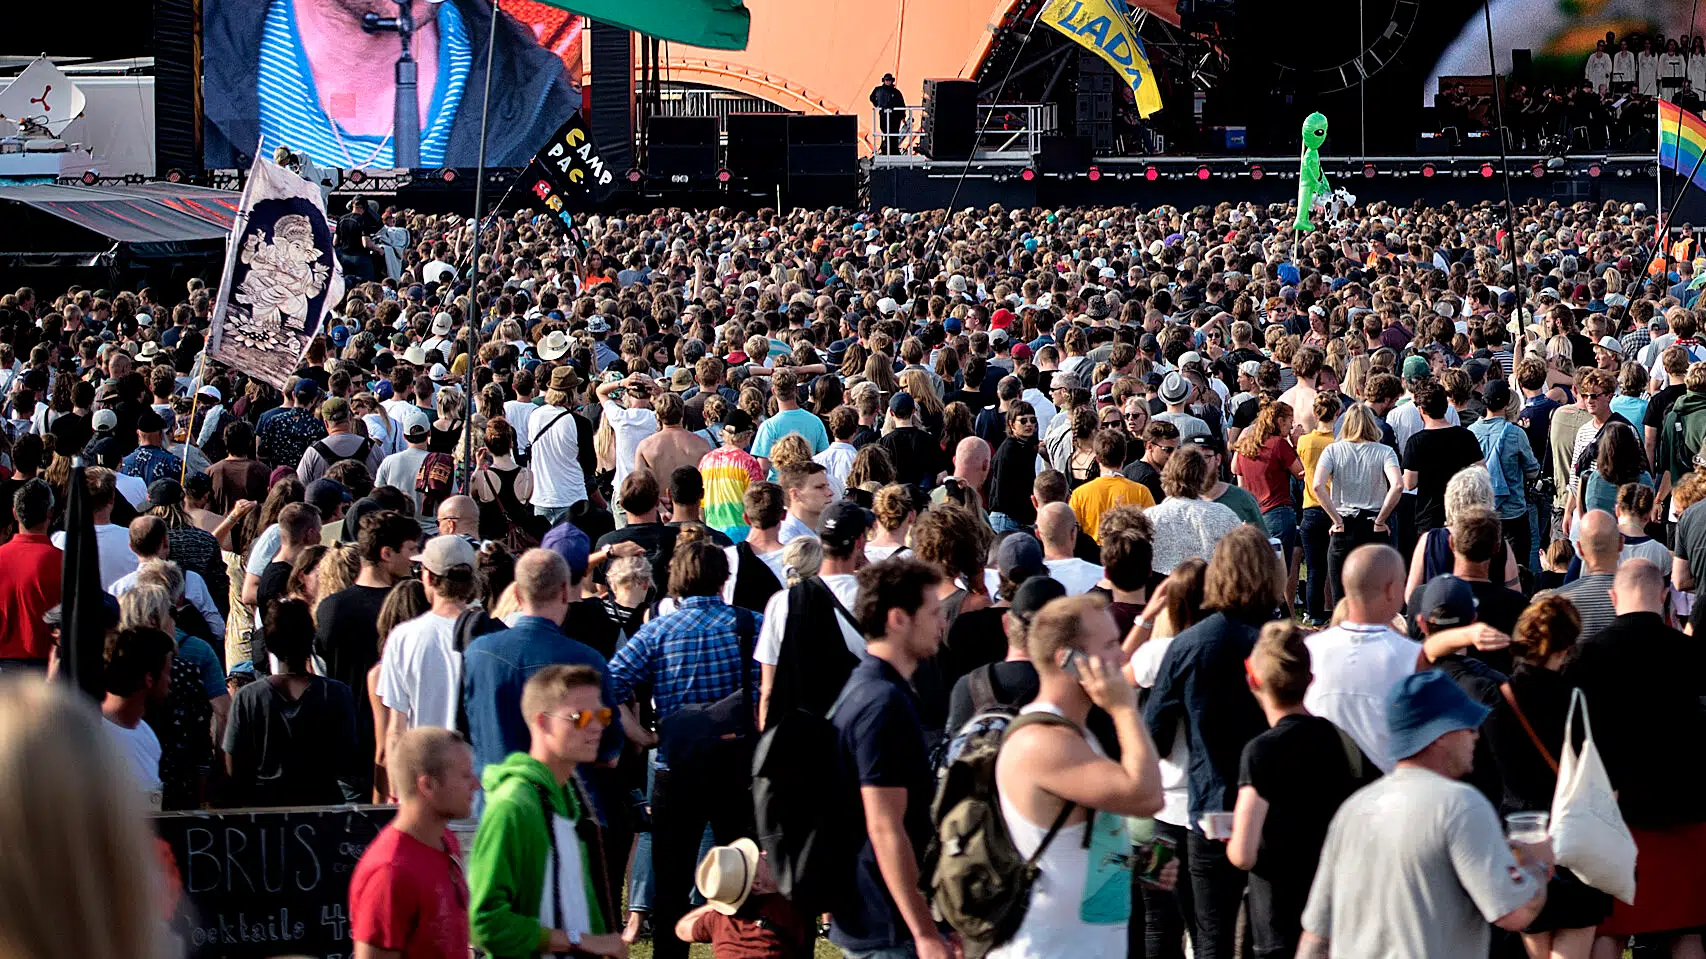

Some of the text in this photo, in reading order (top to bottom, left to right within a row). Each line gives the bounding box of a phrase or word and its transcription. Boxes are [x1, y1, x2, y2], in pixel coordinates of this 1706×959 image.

[547, 142, 585, 183] PAC
[565, 127, 613, 186] CAMP
[186, 824, 322, 893] BRUS
[185, 907, 305, 946] ocktails
